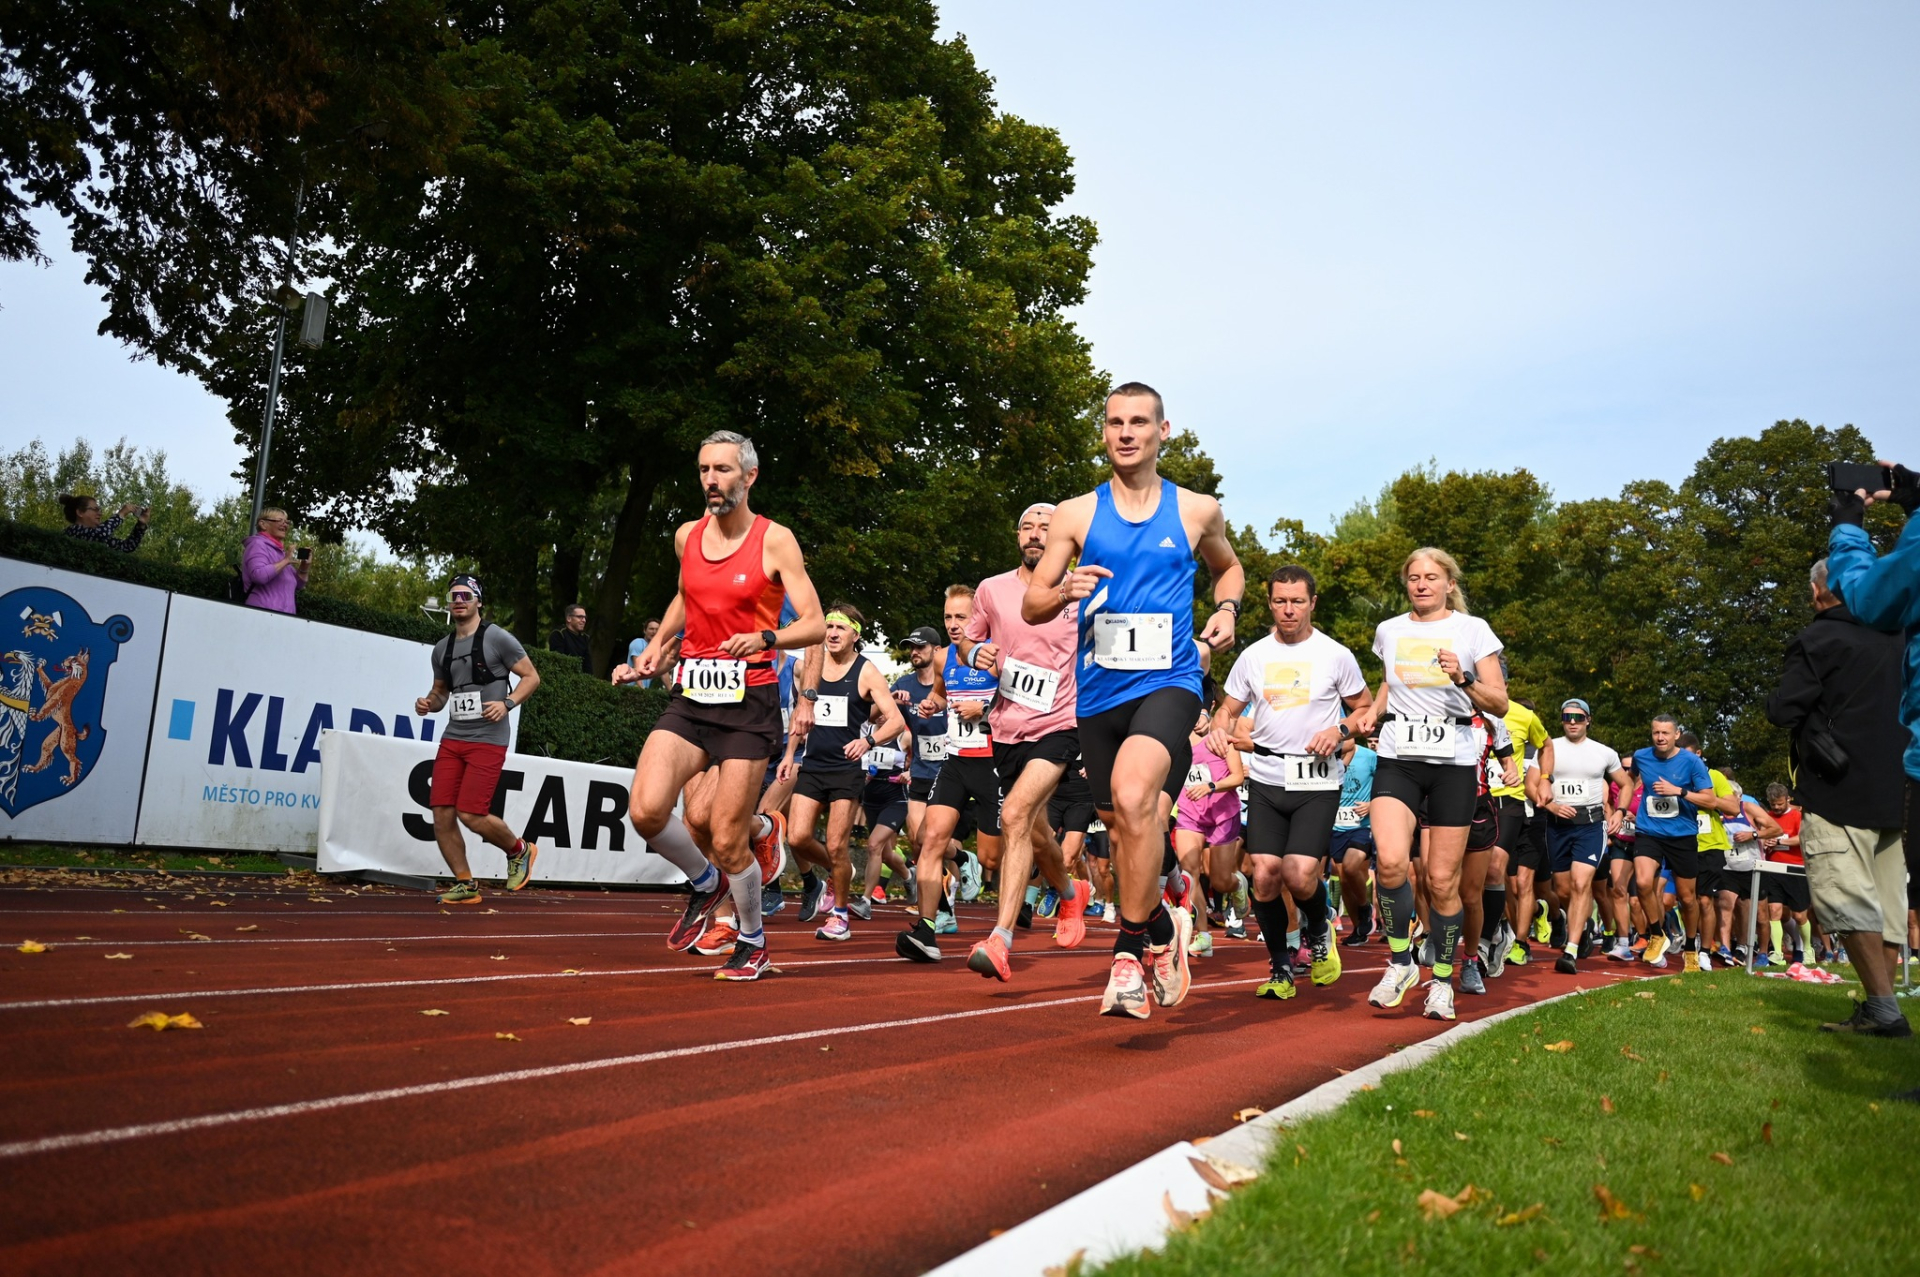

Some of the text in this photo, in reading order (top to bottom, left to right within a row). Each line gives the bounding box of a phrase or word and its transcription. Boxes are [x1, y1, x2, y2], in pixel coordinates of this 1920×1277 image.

[1126, 628, 1138, 652] 1
[688, 669, 741, 690] 1003
[1010, 671, 1045, 697] 101
[454, 698, 475, 712] 142
[822, 703, 831, 717] 3
[957, 722, 973, 737] 19
[1406, 725, 1446, 744] 109
[925, 742, 941, 753] 26
[873, 752, 884, 762] 11
[1188, 770, 1202, 783] 64
[1297, 761, 1329, 779] 110
[202, 784, 260, 805] MĚSTO
[264, 790, 297, 808] PRO
[1561, 784, 1583, 795] 103
[402, 758, 678, 853] SAR
[1655, 801, 1670, 811] 69
[1337, 811, 1355, 821] 123
[1441, 924, 1459, 960] Kalenji
